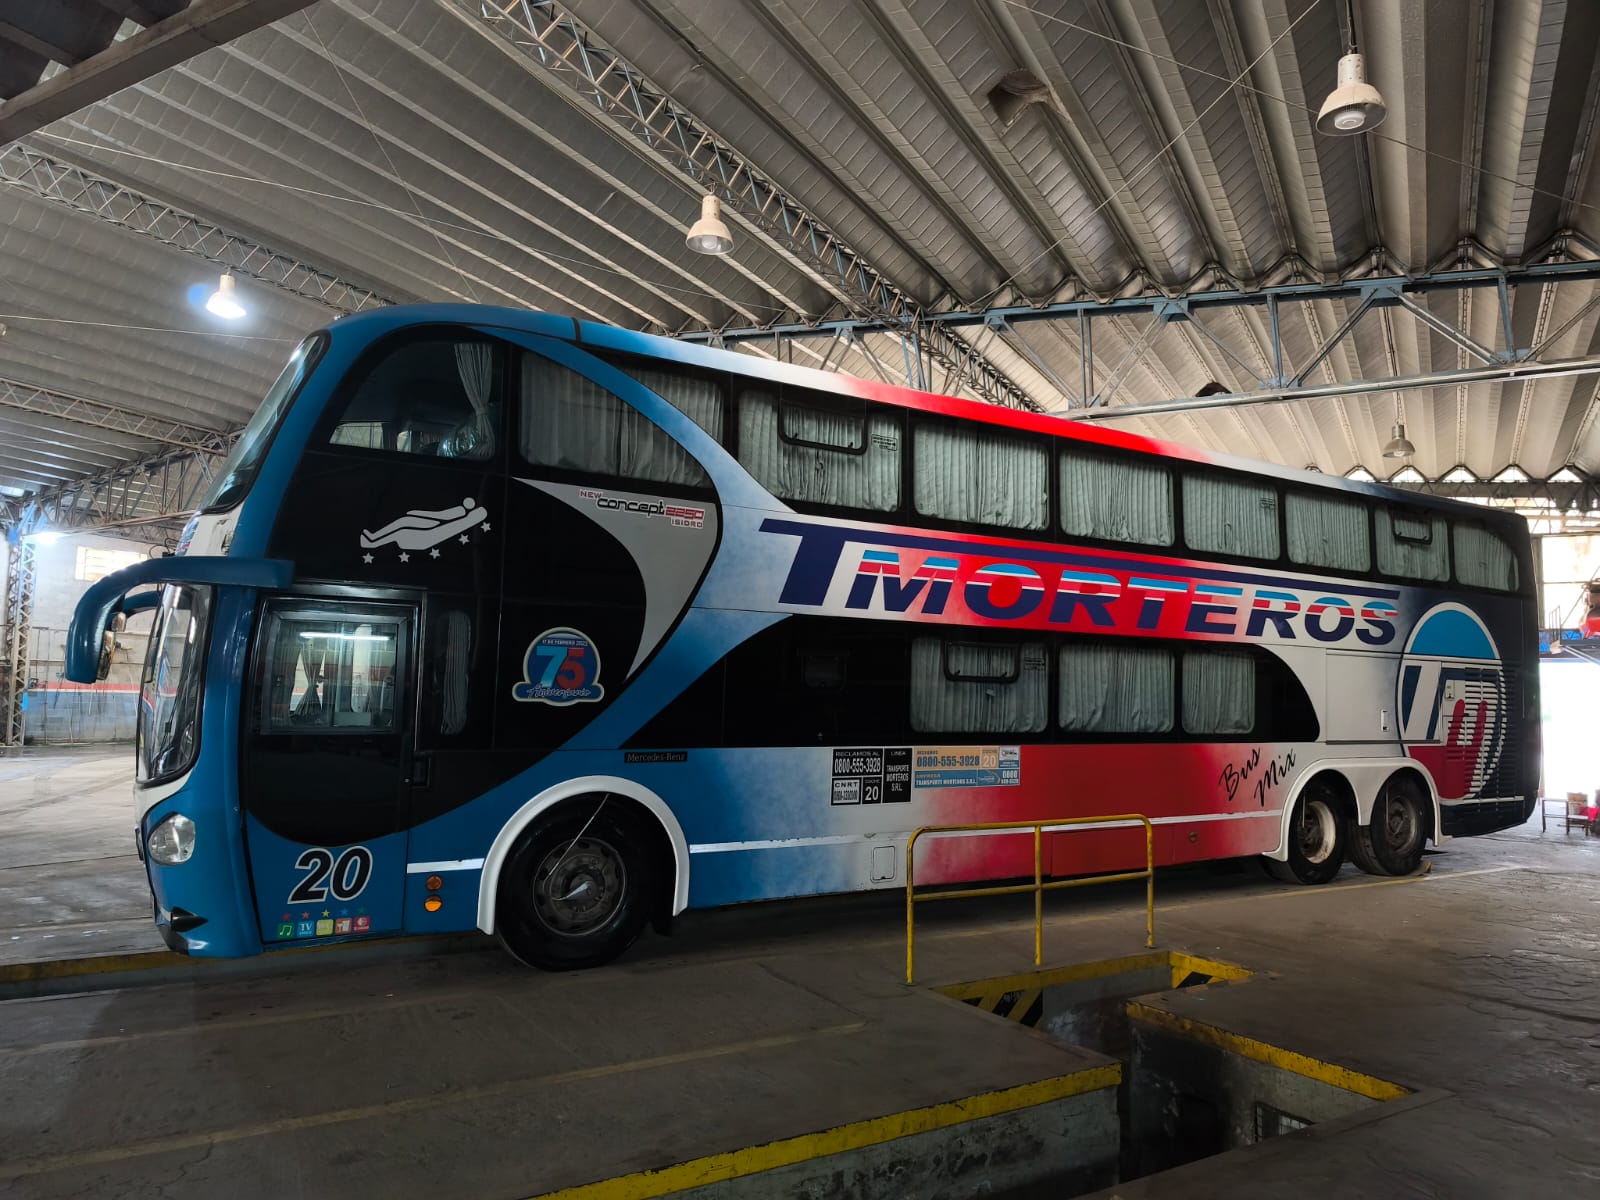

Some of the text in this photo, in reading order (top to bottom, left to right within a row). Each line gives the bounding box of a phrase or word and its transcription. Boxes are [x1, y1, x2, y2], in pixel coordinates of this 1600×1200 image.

[580, 490, 602, 499] NEW
[671, 519, 704, 528] ISIDRO
[537, 645, 586, 690] 75
[626, 752, 685, 762] Mercedes-Benz
[983, 755, 997, 767] 20
[834, 757, 881, 774] 0800-555-3928
[1218, 746, 1261, 802] Bus
[1253, 747, 1297, 808] Mix
[864, 785, 879, 801] 20
[287, 846, 374, 905] 20
